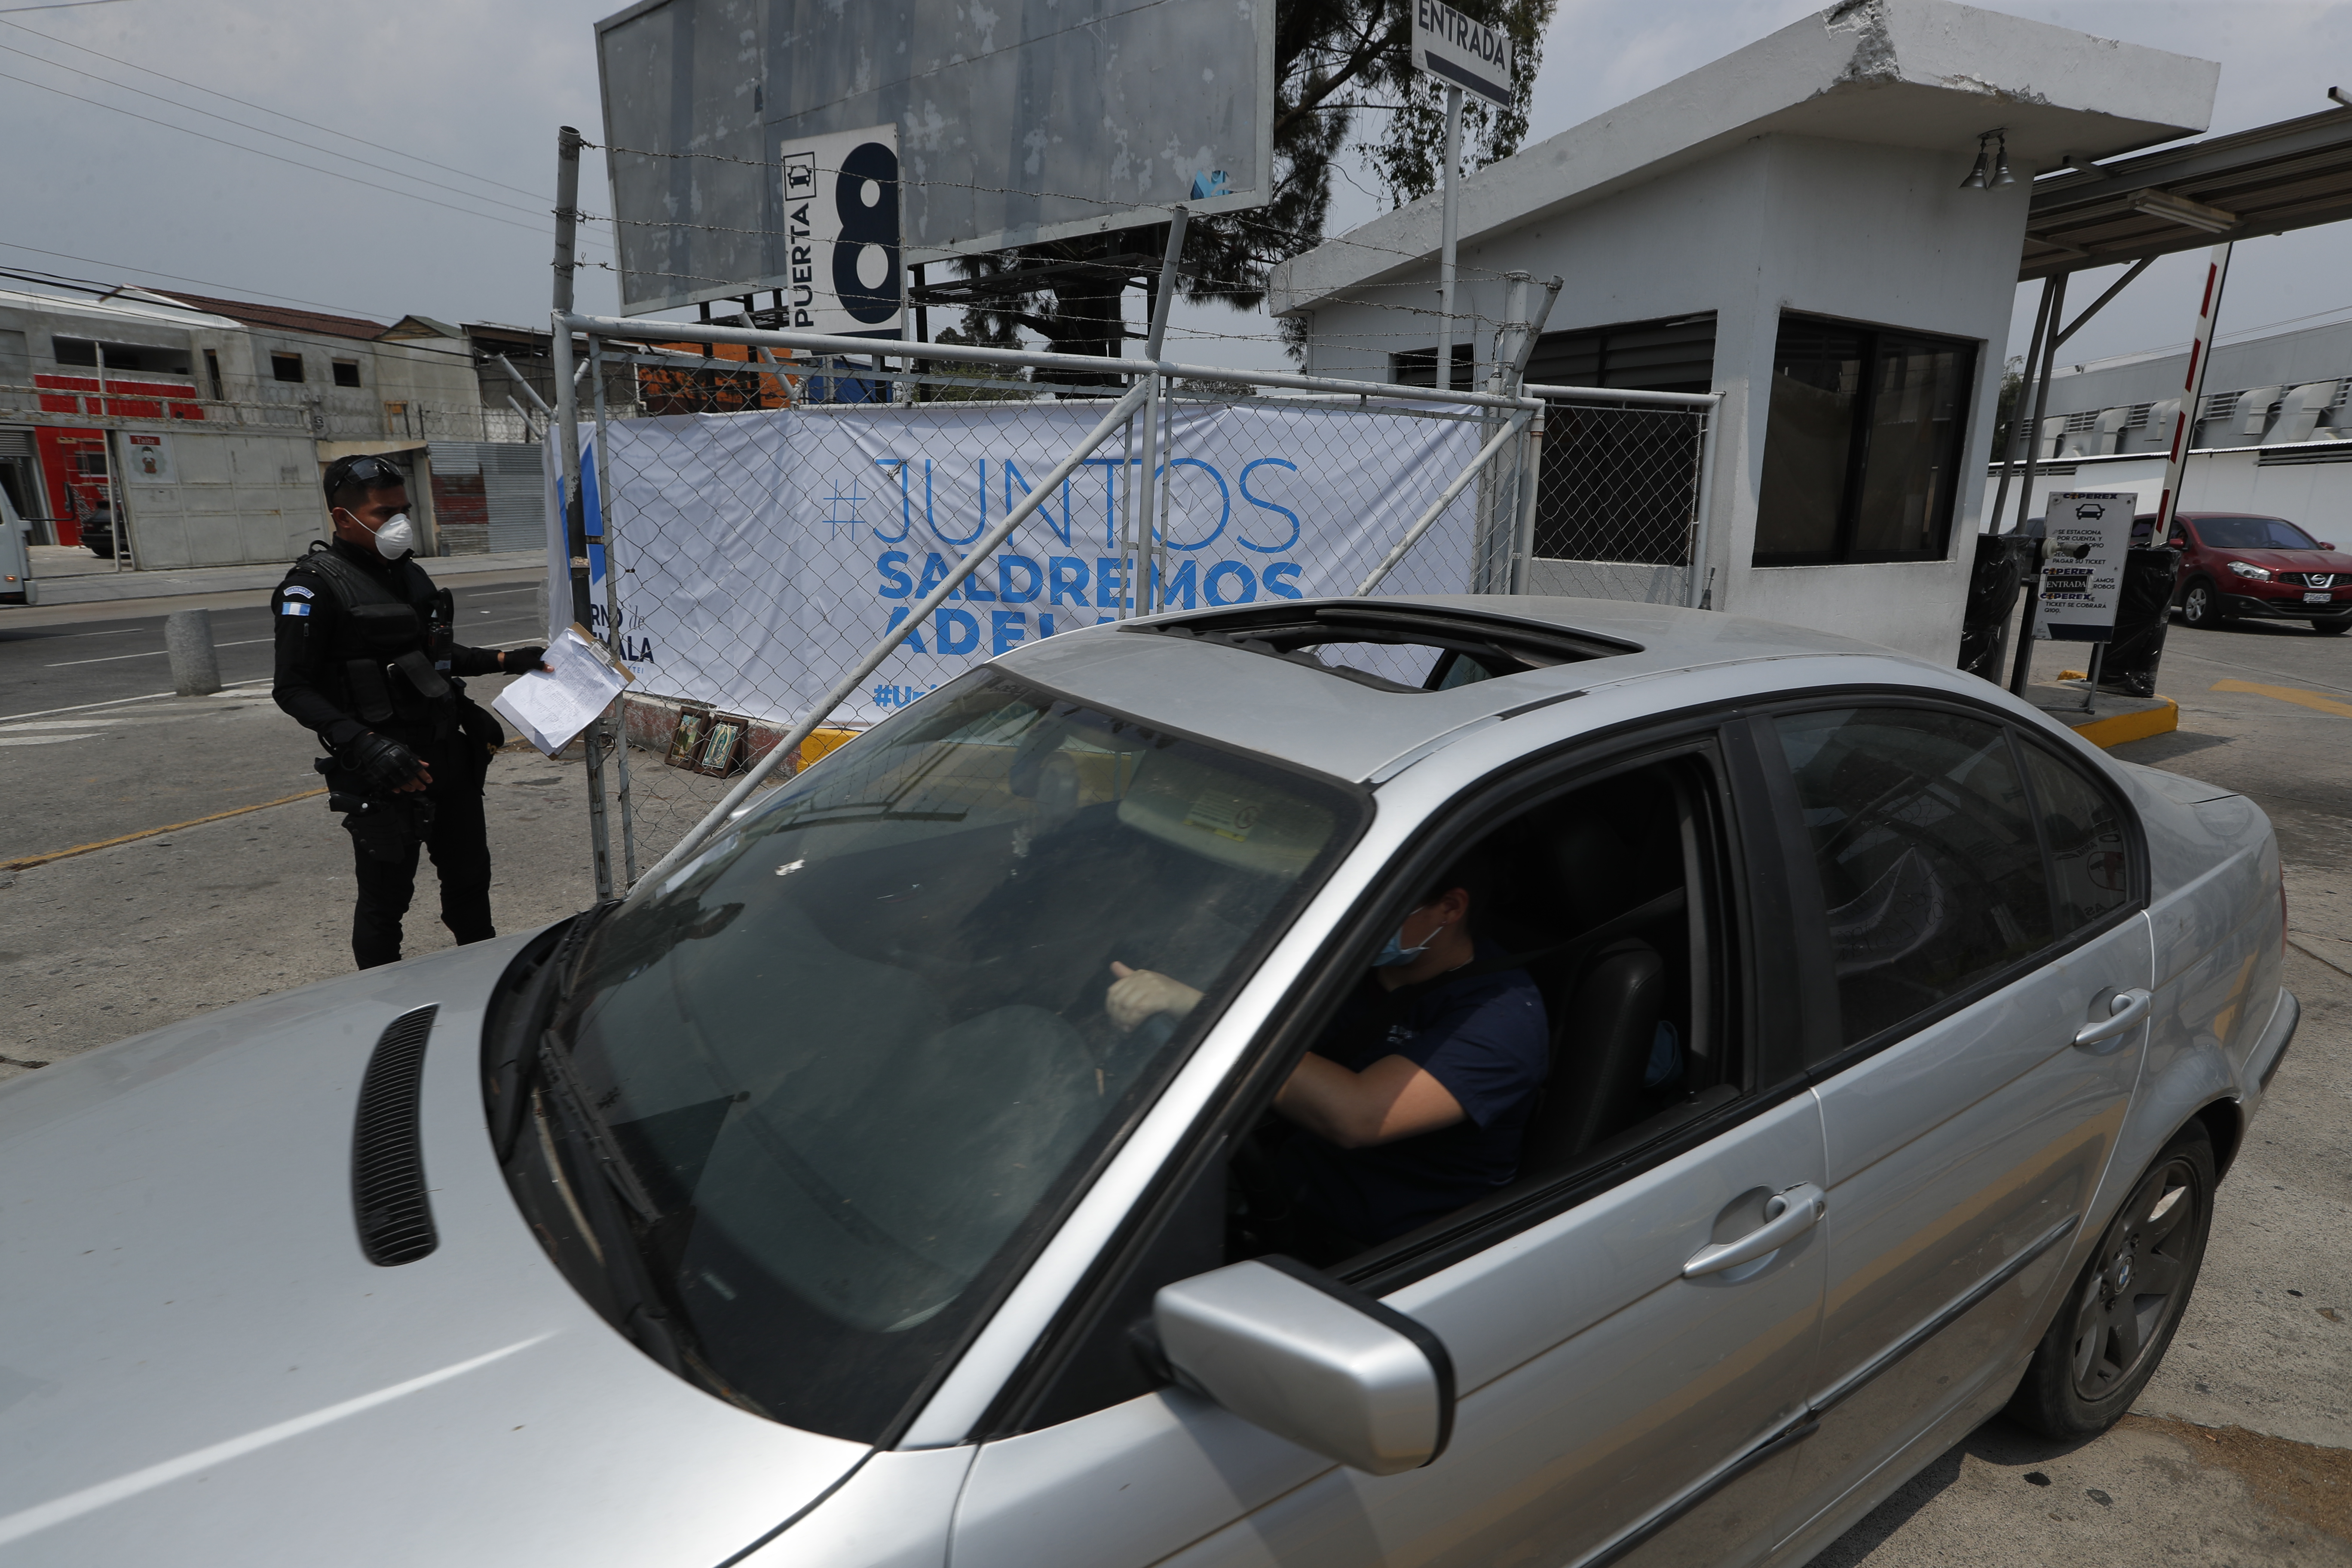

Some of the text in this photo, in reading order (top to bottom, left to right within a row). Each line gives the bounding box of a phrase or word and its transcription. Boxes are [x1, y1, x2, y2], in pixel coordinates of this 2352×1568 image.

[1418, 0, 1505, 70] ENTRADA
[790, 202, 814, 327] PUERTA
[832, 142, 901, 324] 8
[877, 549, 1304, 609] SALDREMOS
[629, 605, 645, 631] de
